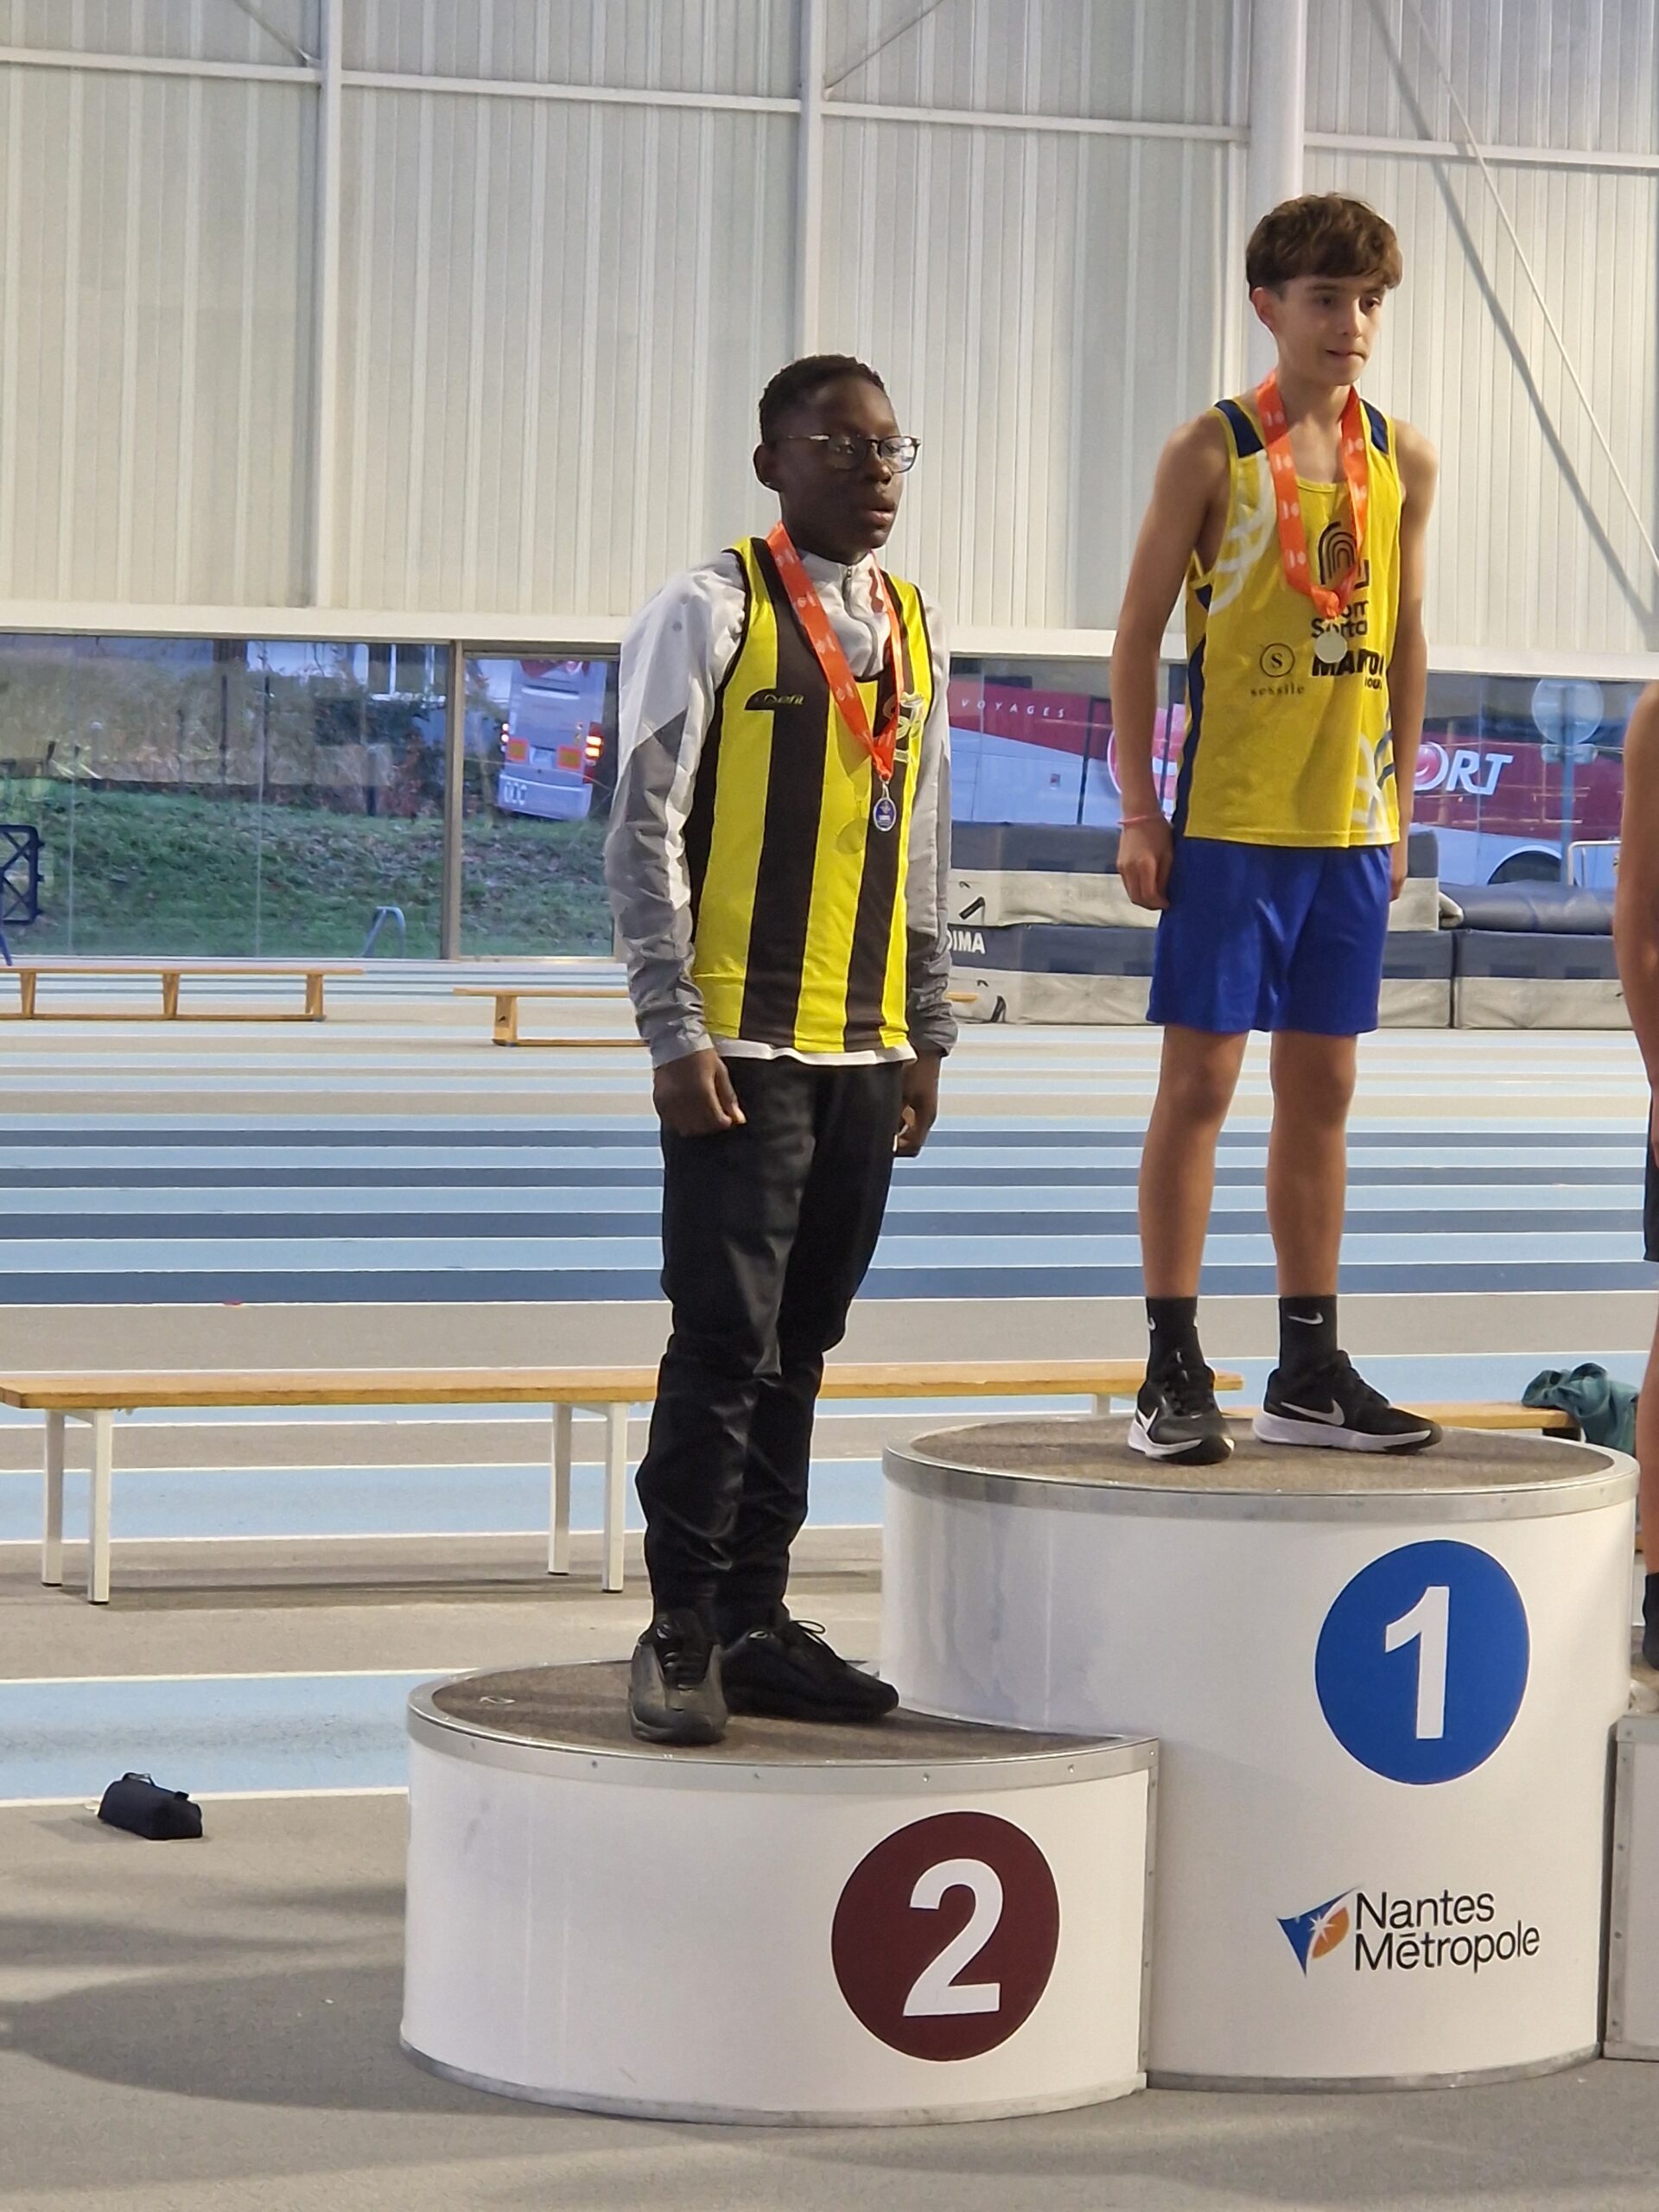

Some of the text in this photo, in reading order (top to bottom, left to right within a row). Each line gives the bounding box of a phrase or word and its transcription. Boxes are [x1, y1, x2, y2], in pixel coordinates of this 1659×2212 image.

[961, 699, 1065, 718] VOYAGES
[1384, 1586, 1450, 1739] 1
[903, 1858, 1003, 2017] 2
[1356, 1889, 1495, 1930] Nantes
